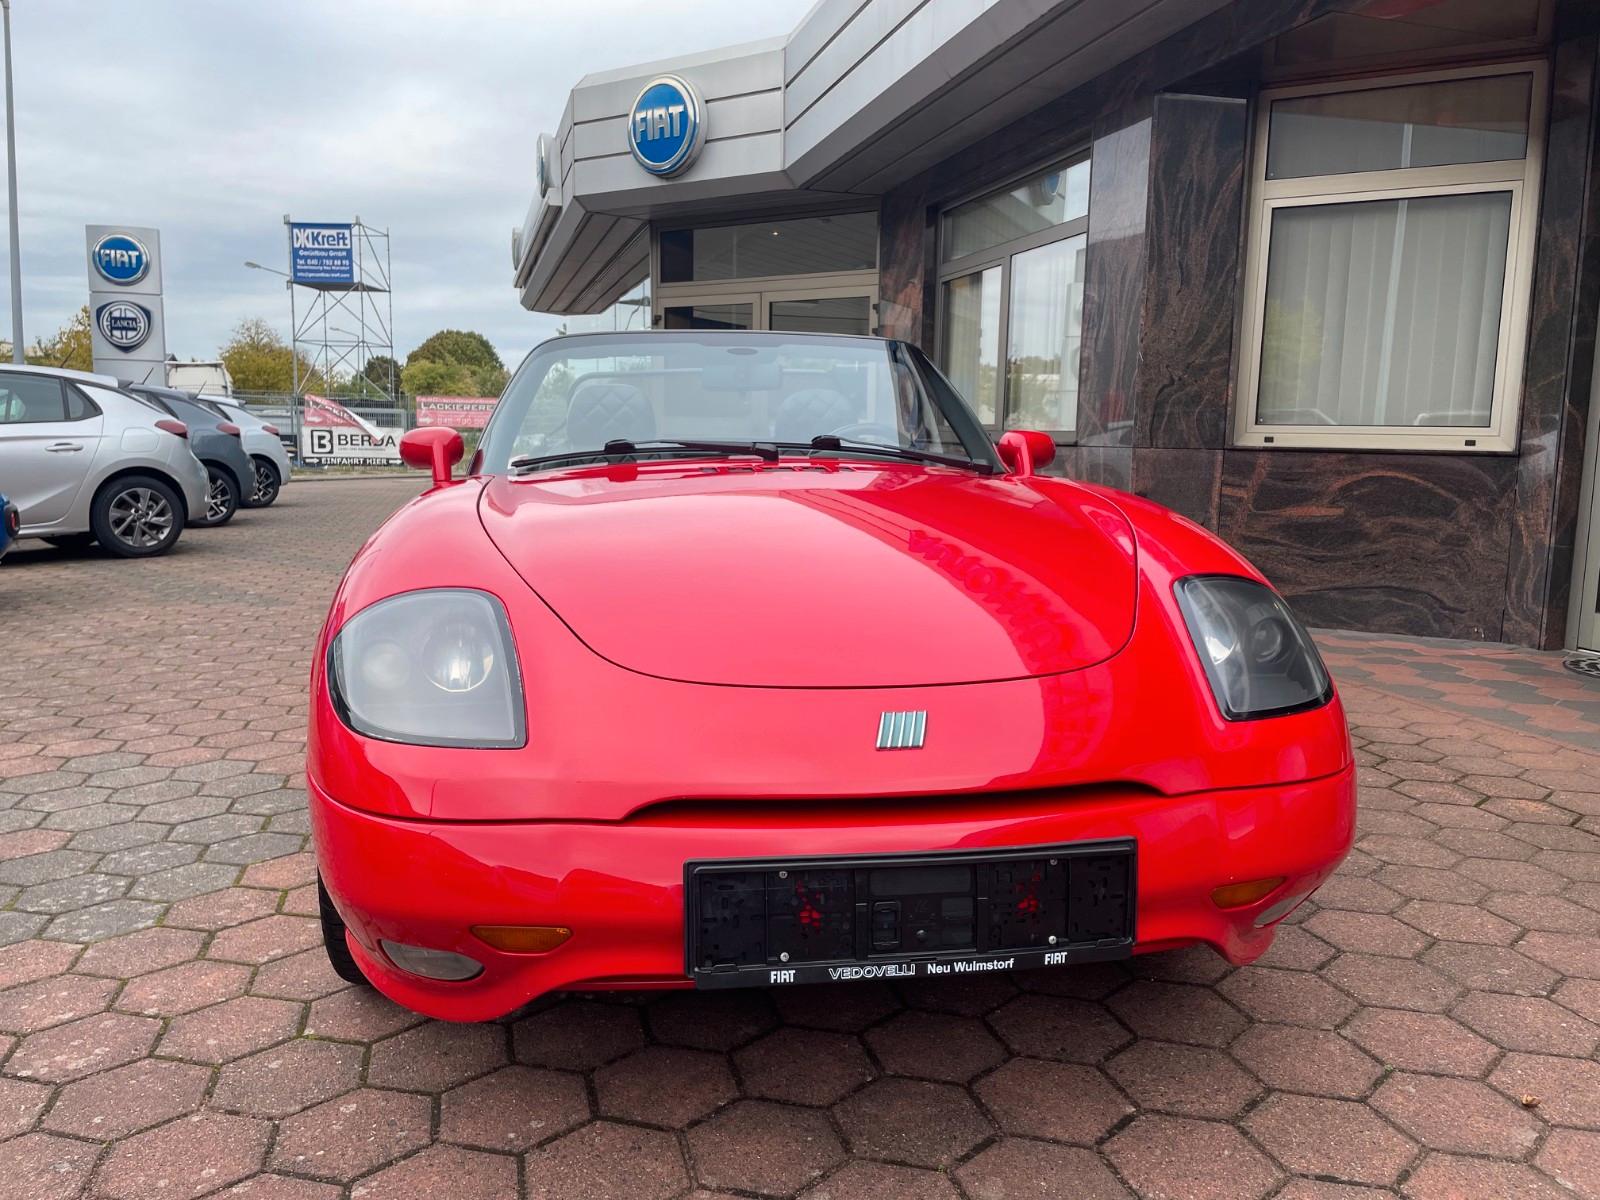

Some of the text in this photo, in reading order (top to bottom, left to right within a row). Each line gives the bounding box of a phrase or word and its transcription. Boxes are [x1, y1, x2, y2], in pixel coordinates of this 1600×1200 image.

[635, 104, 684, 143] FIAT
[311, 231, 348, 246] Kreft
[100, 249, 139, 268] FIAT
[111, 319, 137, 329] LANCIA
[321, 457, 387, 465] EINFAHRT HIER
[1044, 952, 1068, 965] FIAT
[828, 958, 1014, 980] VEDOVELLI Neu Wulmstorf
[770, 970, 796, 983] FIAT
